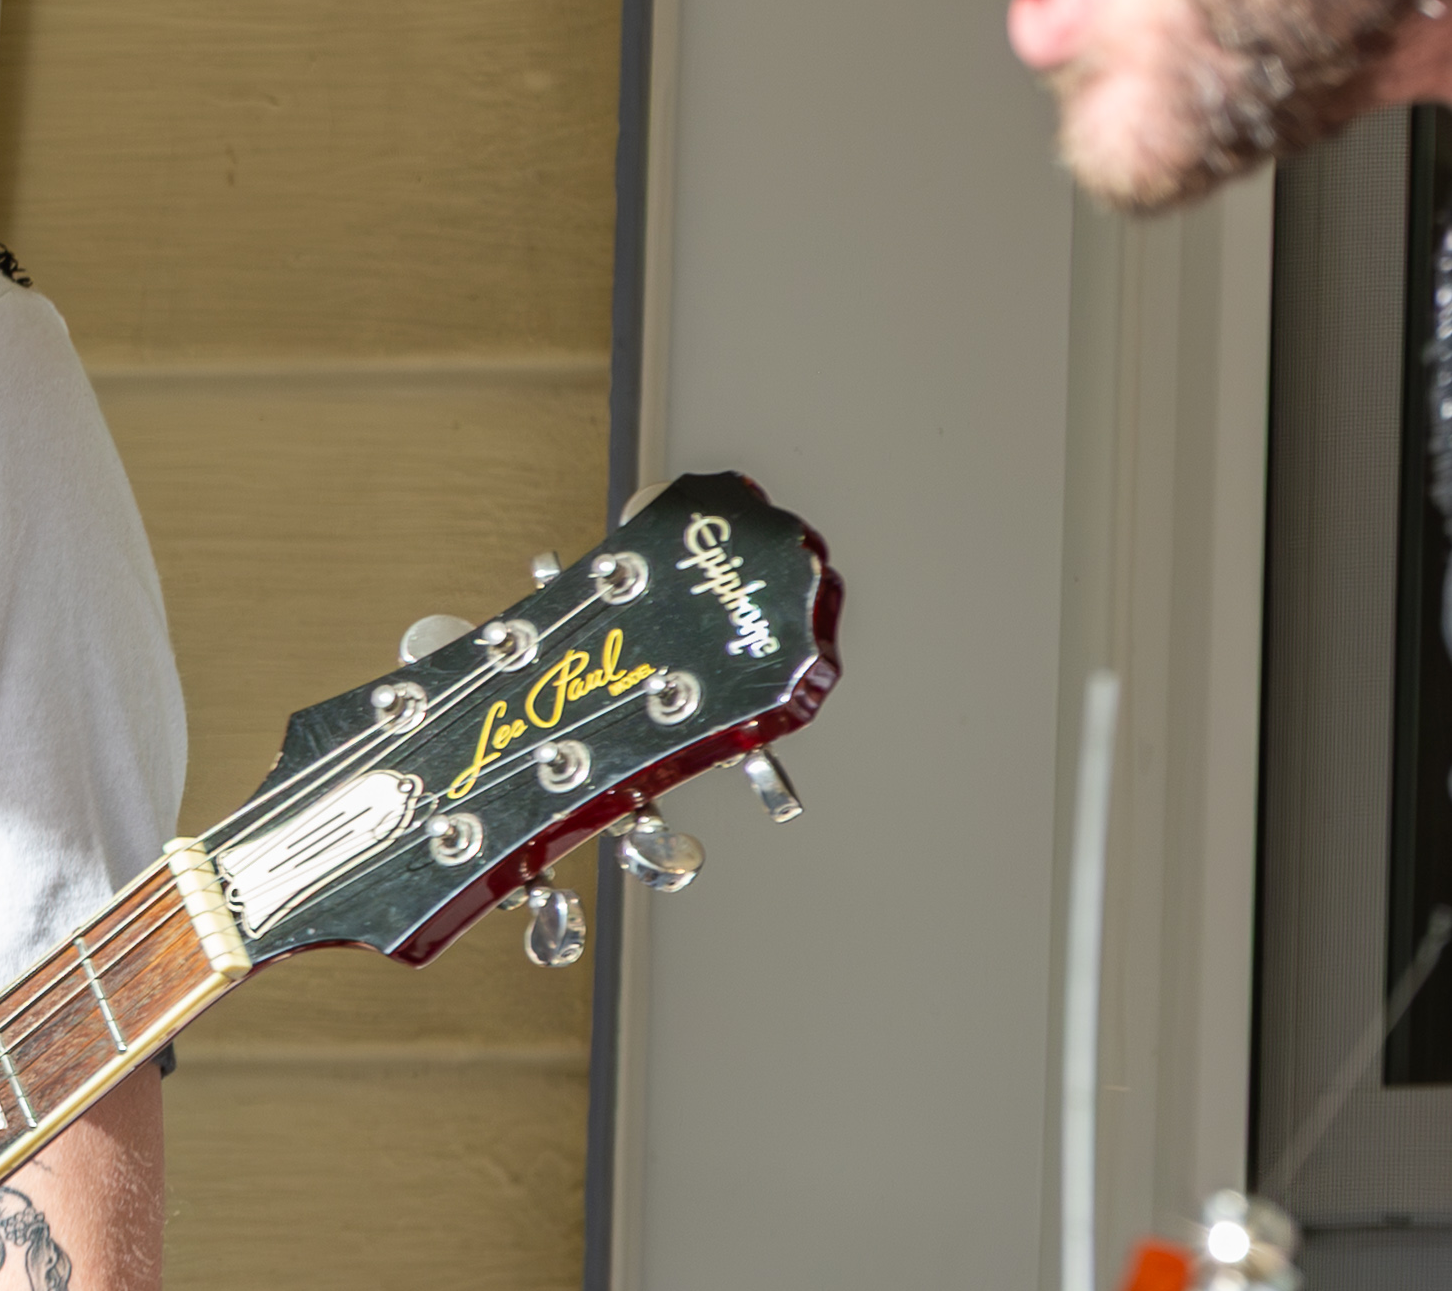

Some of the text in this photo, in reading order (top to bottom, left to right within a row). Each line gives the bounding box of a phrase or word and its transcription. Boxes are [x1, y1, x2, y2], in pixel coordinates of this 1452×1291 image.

[676, 512, 781, 659] Epiphone
[446, 628, 628, 799] Les Paul
